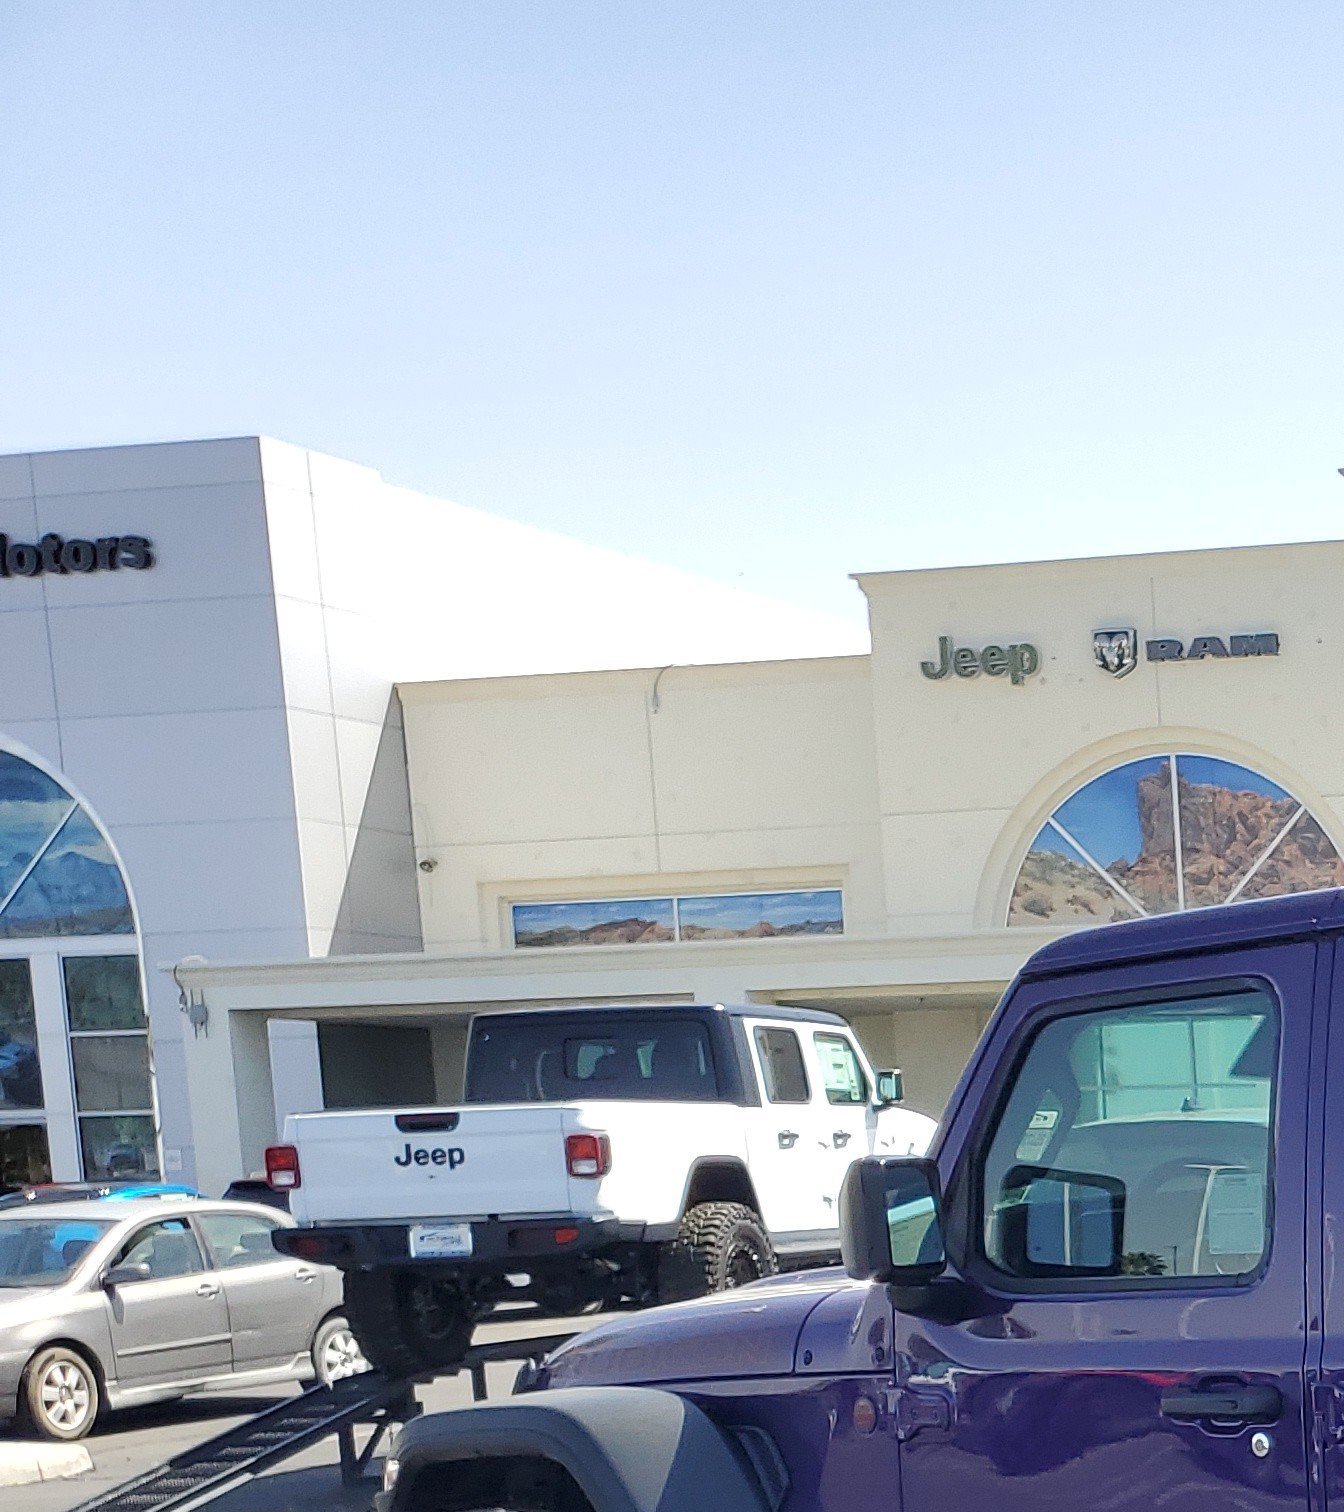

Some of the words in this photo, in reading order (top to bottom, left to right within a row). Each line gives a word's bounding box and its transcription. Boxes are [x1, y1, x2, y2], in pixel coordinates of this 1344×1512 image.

[0, 532, 155, 577] otors
[920, 635, 1040, 686] Jeep
[1146, 633, 1280, 663] RAM
[393, 1143, 465, 1170] Jeep
